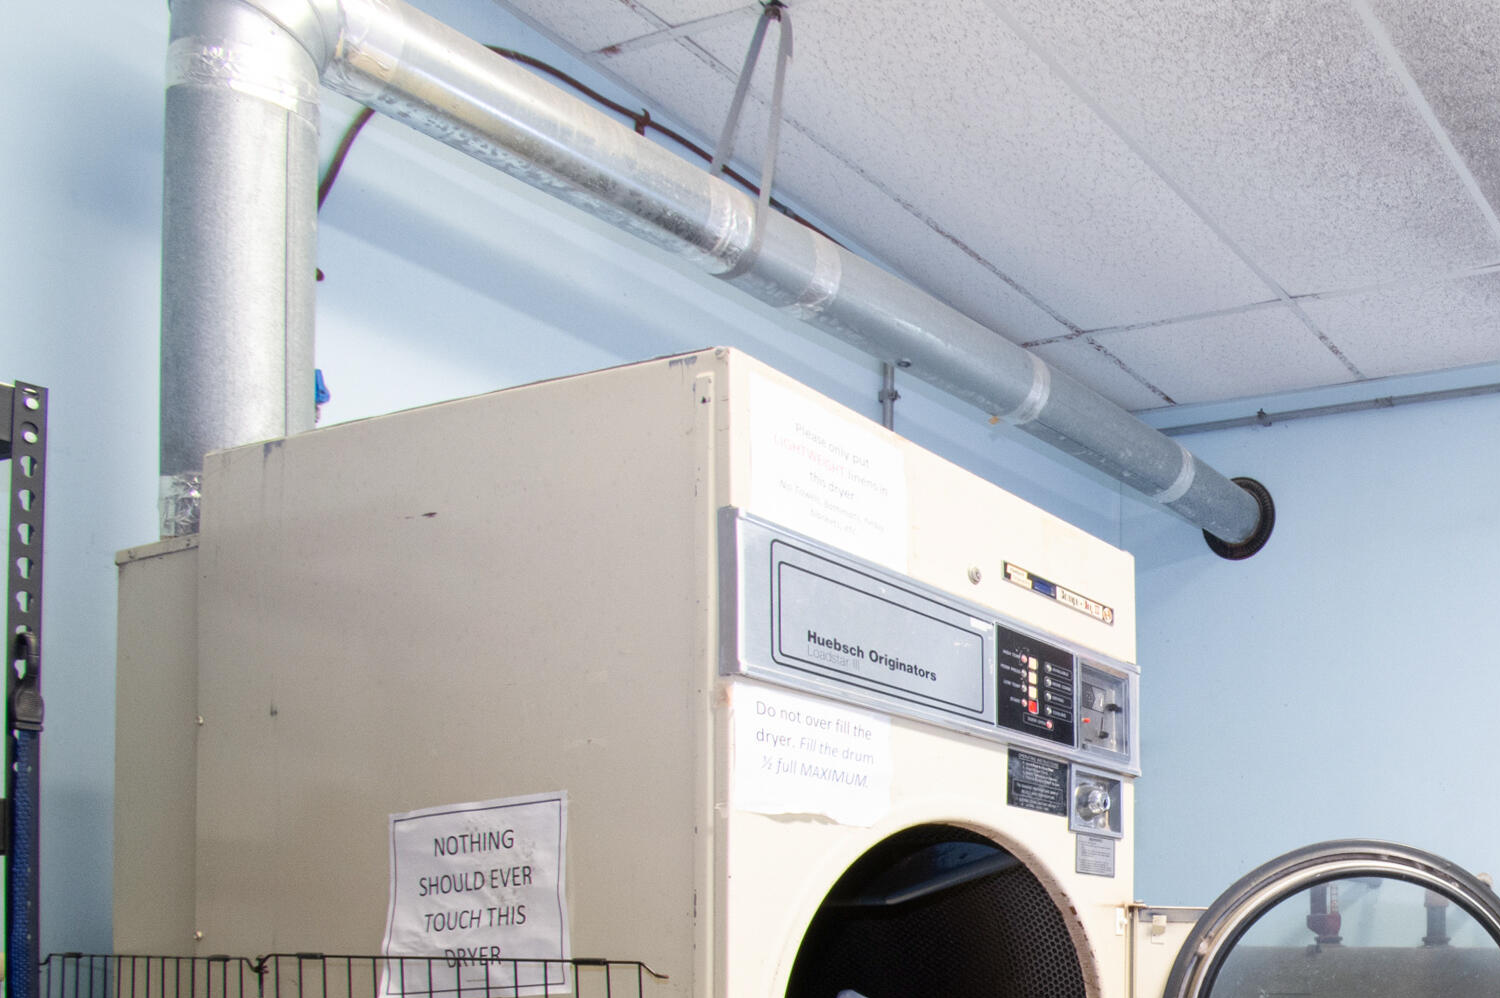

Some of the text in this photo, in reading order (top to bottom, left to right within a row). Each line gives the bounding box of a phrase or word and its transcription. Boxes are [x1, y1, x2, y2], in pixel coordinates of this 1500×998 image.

[794, 422, 870, 470] Please only put
[807, 630, 938, 682] Huebsch Originators
[807, 644, 849, 668] Loadstar
[756, 700, 873, 740] Do not over fill the
[756, 728, 875, 764] dryer. Fill the drum
[776, 757, 798, 776] full
[800, 762, 869, 788] MAXIMUM.
[434, 828, 515, 857] NOTHING
[419, 865, 533, 897] SHOULD EVER
[425, 905, 527, 933] TOUCH THIS
[445, 945, 502, 968] DRYER
